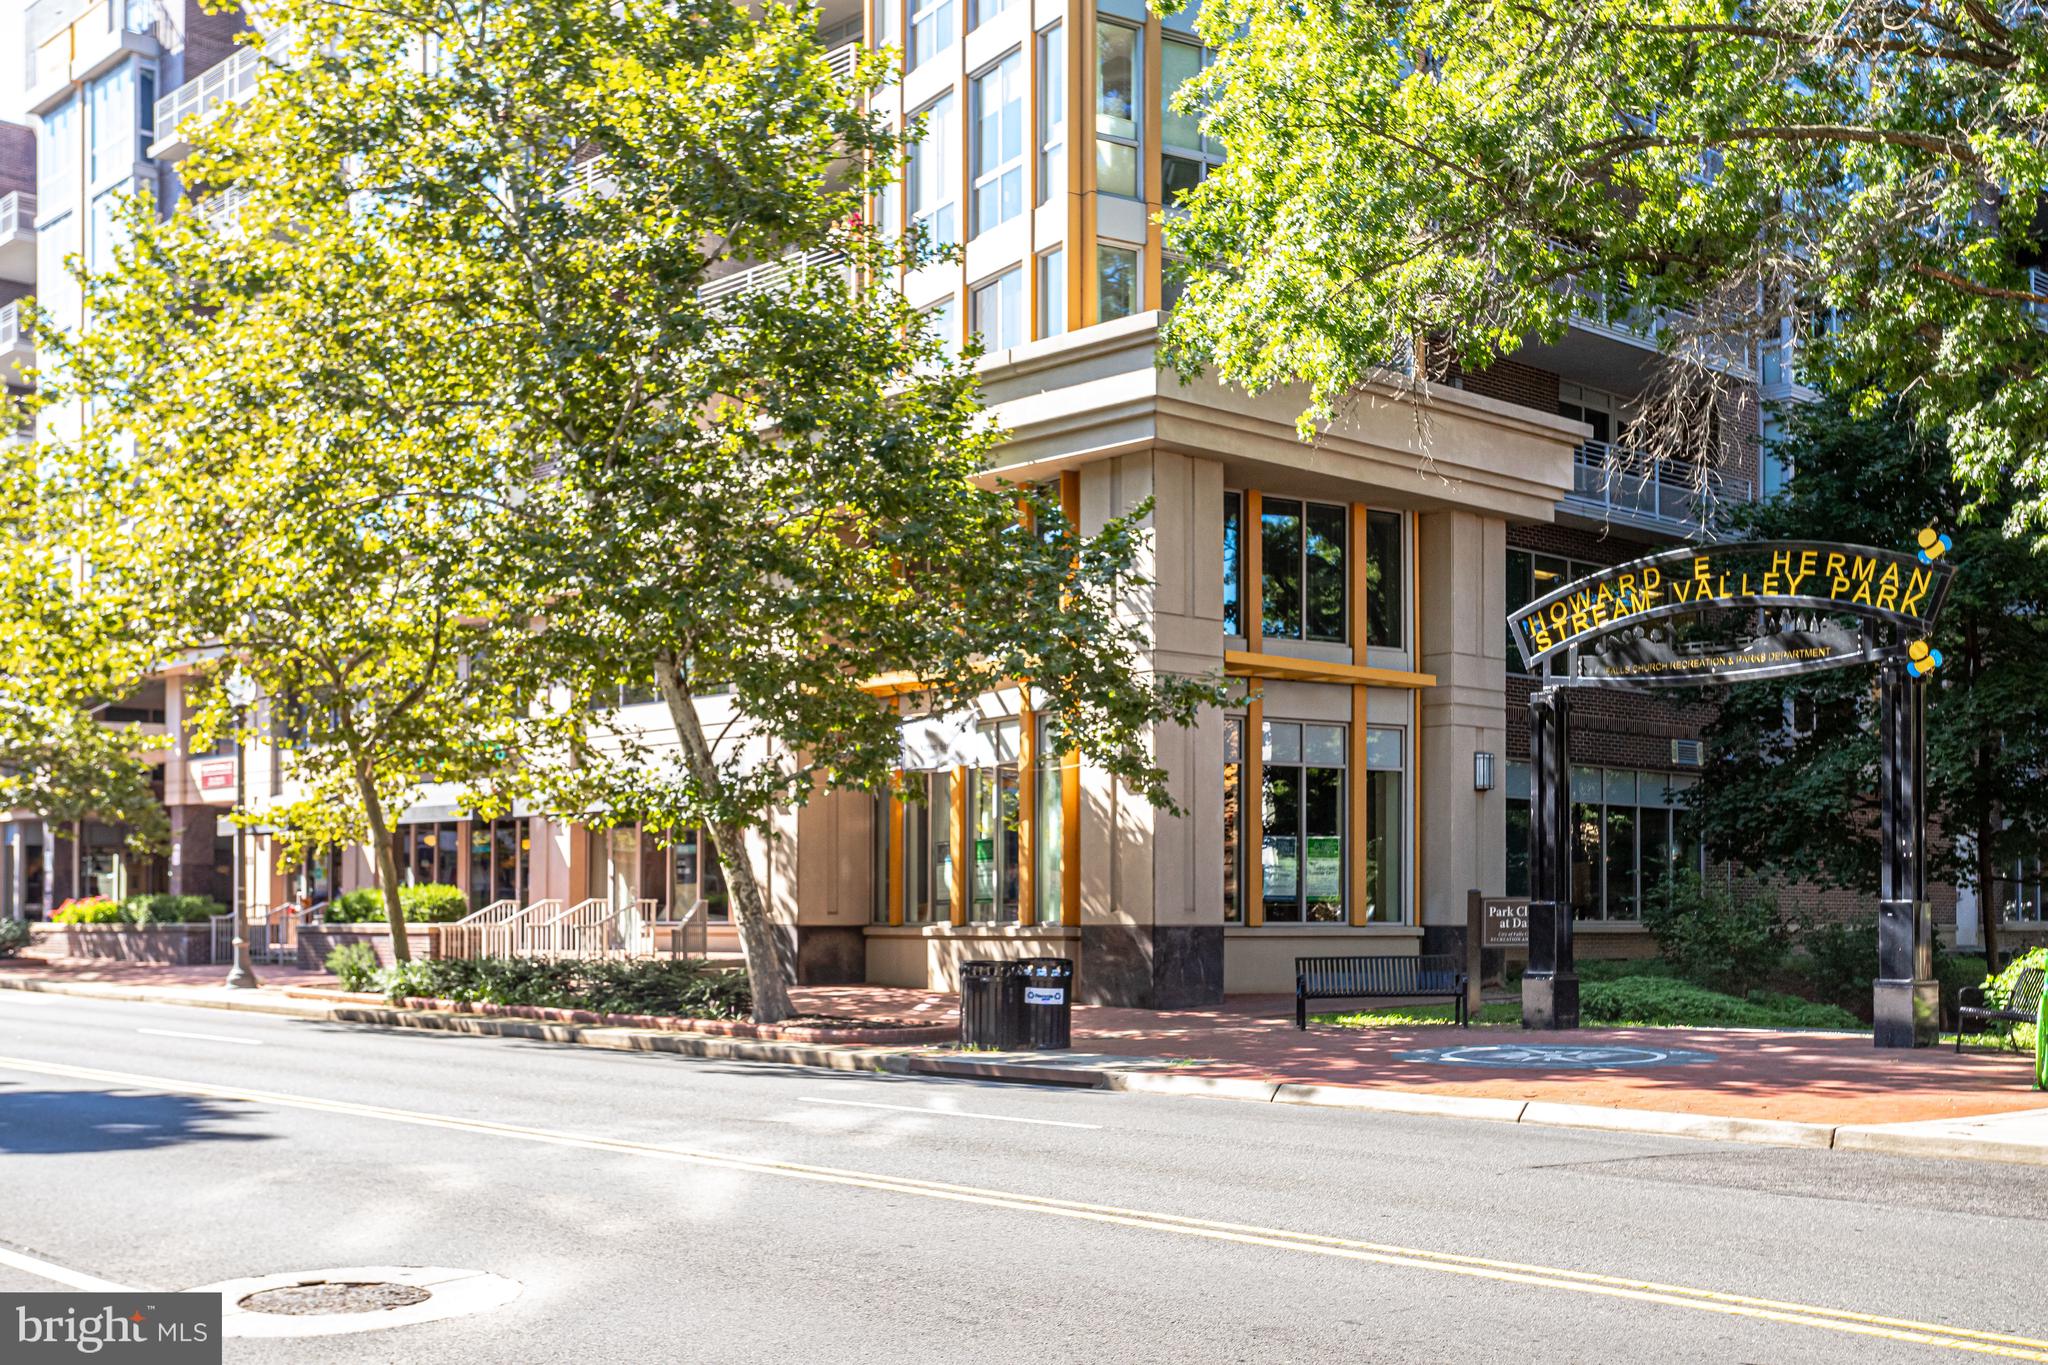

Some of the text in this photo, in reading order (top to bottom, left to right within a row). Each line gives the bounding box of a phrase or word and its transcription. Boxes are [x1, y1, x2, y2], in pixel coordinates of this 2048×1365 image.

[1527, 567, 1661, 637] HOWARD
[1771, 550, 1933, 596] HERMAN
[1535, 571, 1925, 653] STREAM VALLEY PARK
[1632, 661, 1668, 674] CHURCH
[1670, 655, 1725, 669] RECREATION
[1727, 658, 1735, 667] &
[1768, 646, 1832, 662] DEPARTMENT
[1489, 905, 1528, 917] Park Cl
[1499, 917, 1528, 929] at Da
